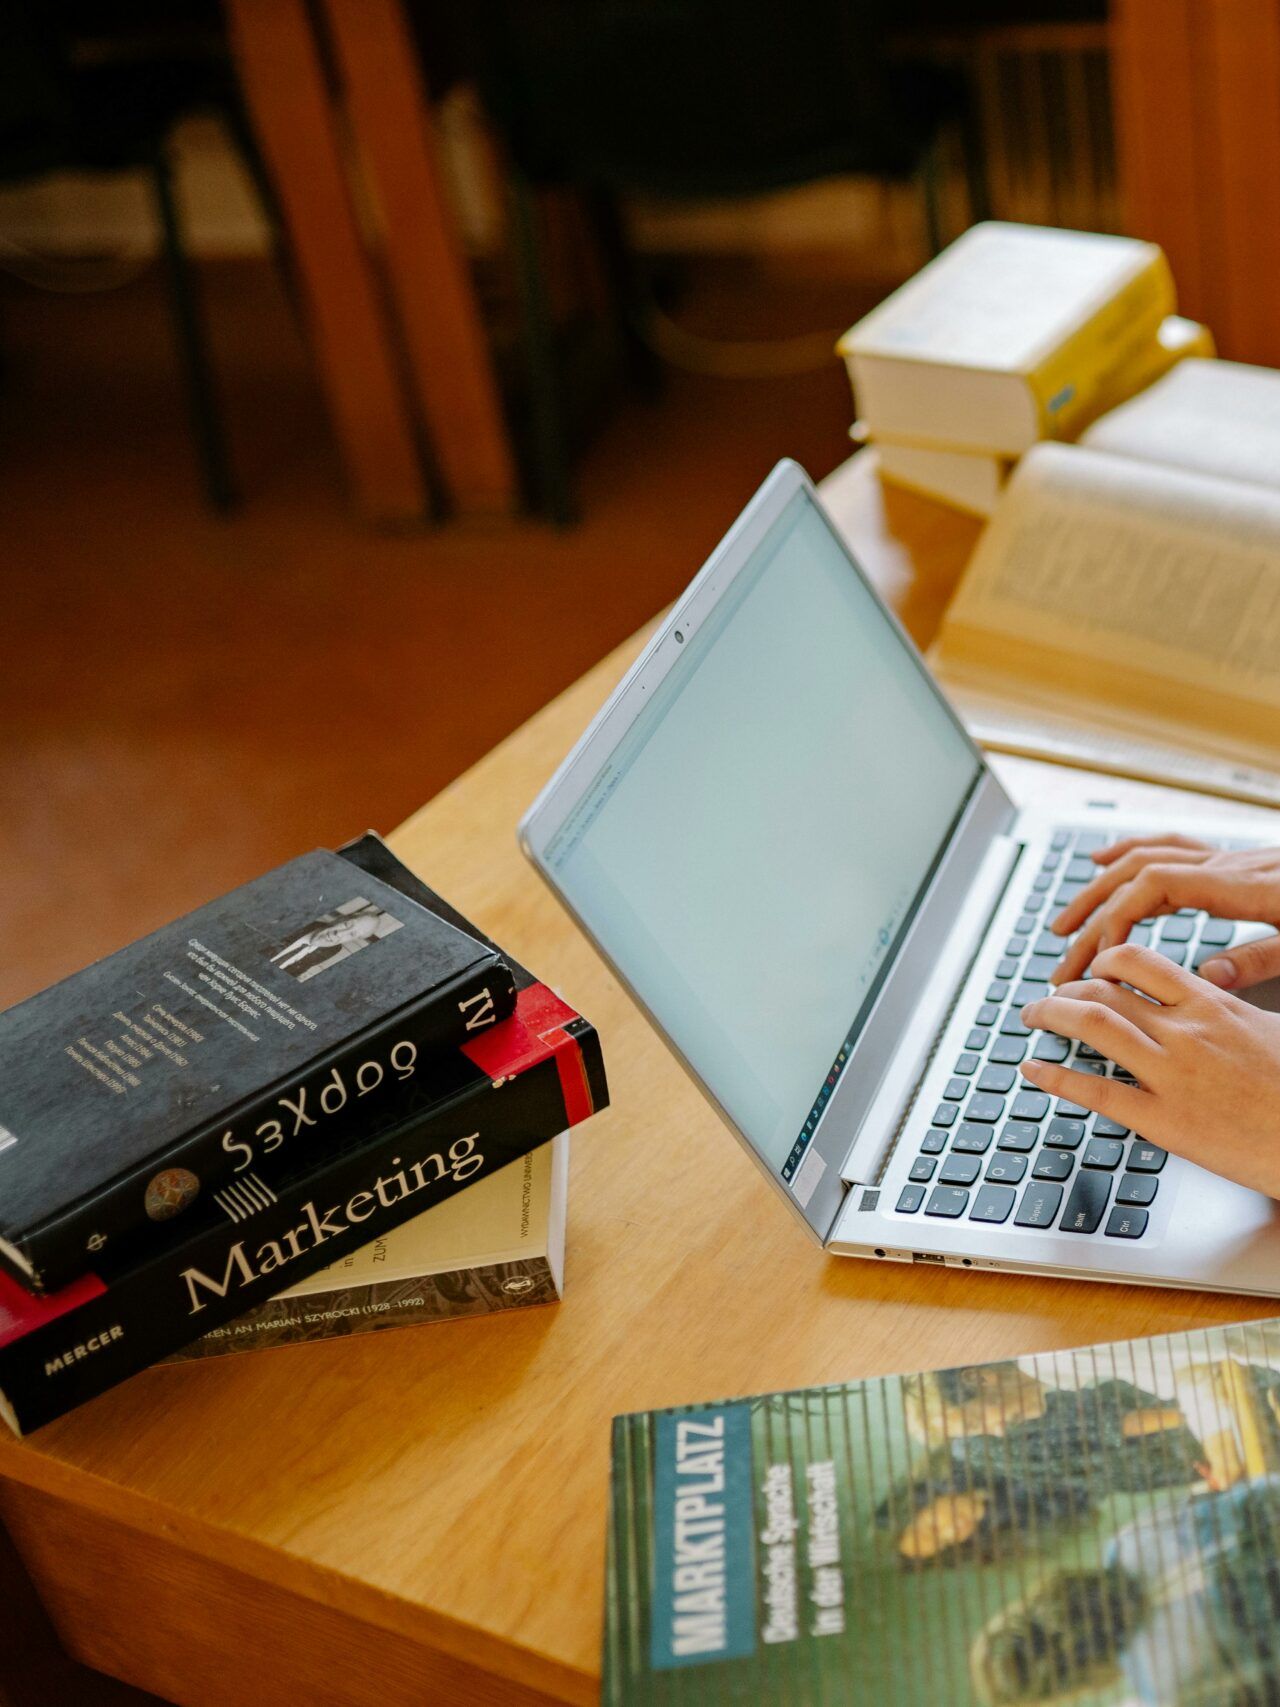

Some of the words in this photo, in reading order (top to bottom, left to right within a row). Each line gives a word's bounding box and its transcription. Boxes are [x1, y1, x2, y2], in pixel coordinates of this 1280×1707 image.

[179, 1132, 484, 1315] Marketing
[1075, 1212, 1086, 1228] Shift
[1120, 1220, 1131, 1233] Ctrl
[373, 1238, 388, 1263] ZUM
[234, 1324, 253, 1335] AN
[256, 1317, 301, 1333] MARIAN
[304, 1307, 360, 1323] SZYROCKI
[45, 1325, 124, 1376] MERCER
[761, 1462, 800, 1544] Sprache
[807, 1460, 841, 1567] Wirtschaft
[672, 1416, 726, 1656] MARKTPLATZ
[761, 1544, 798, 1643] Deutsche
[810, 1567, 843, 1608] der
